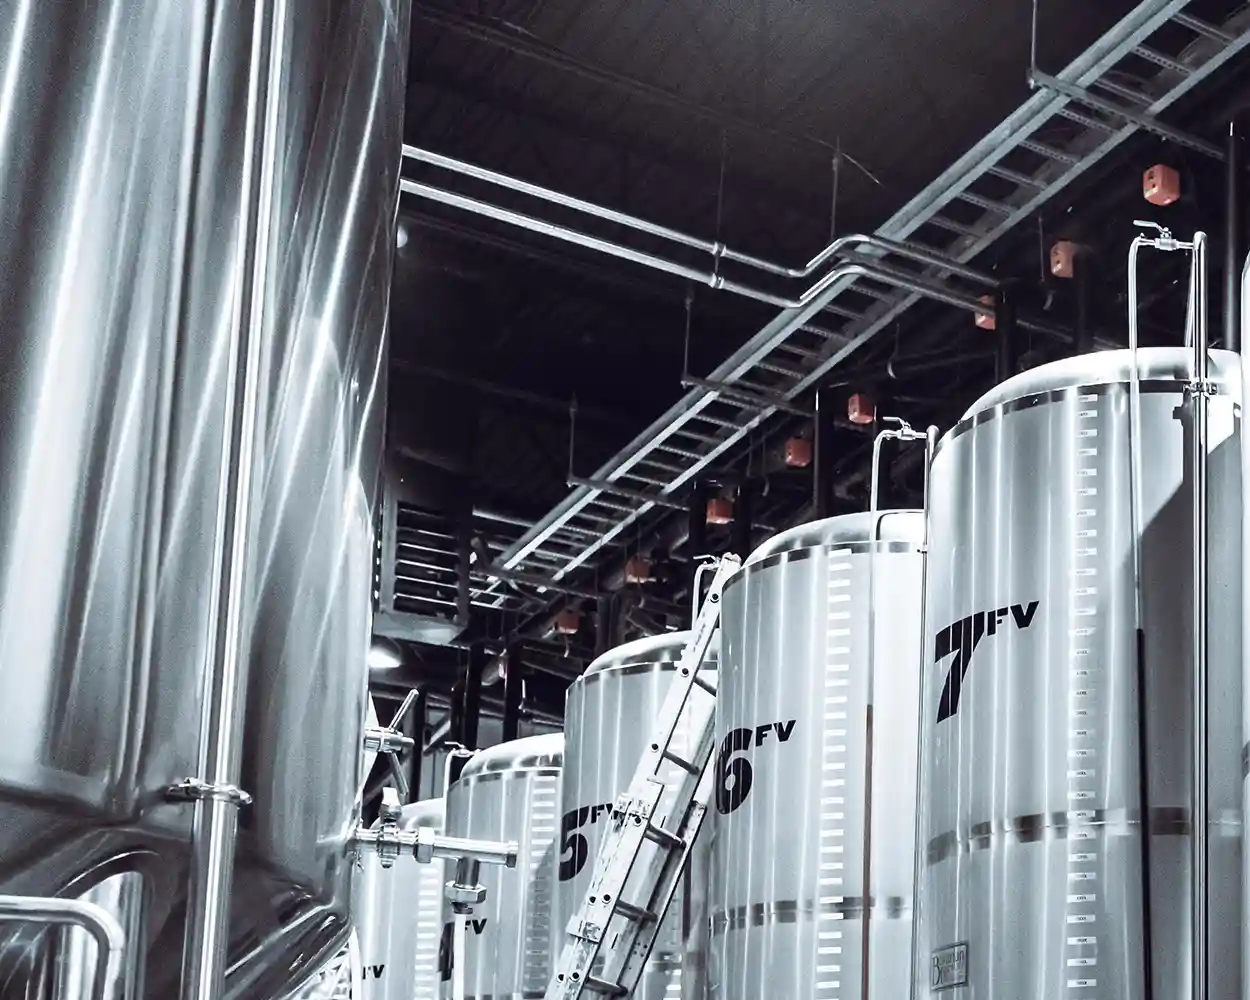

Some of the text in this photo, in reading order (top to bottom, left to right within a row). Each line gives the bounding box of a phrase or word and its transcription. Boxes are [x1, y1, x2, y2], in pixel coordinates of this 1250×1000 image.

[935, 600, 1040, 724] 7 FV
[715, 719, 797, 815] 6 FV
[559, 805, 590, 882] 5
